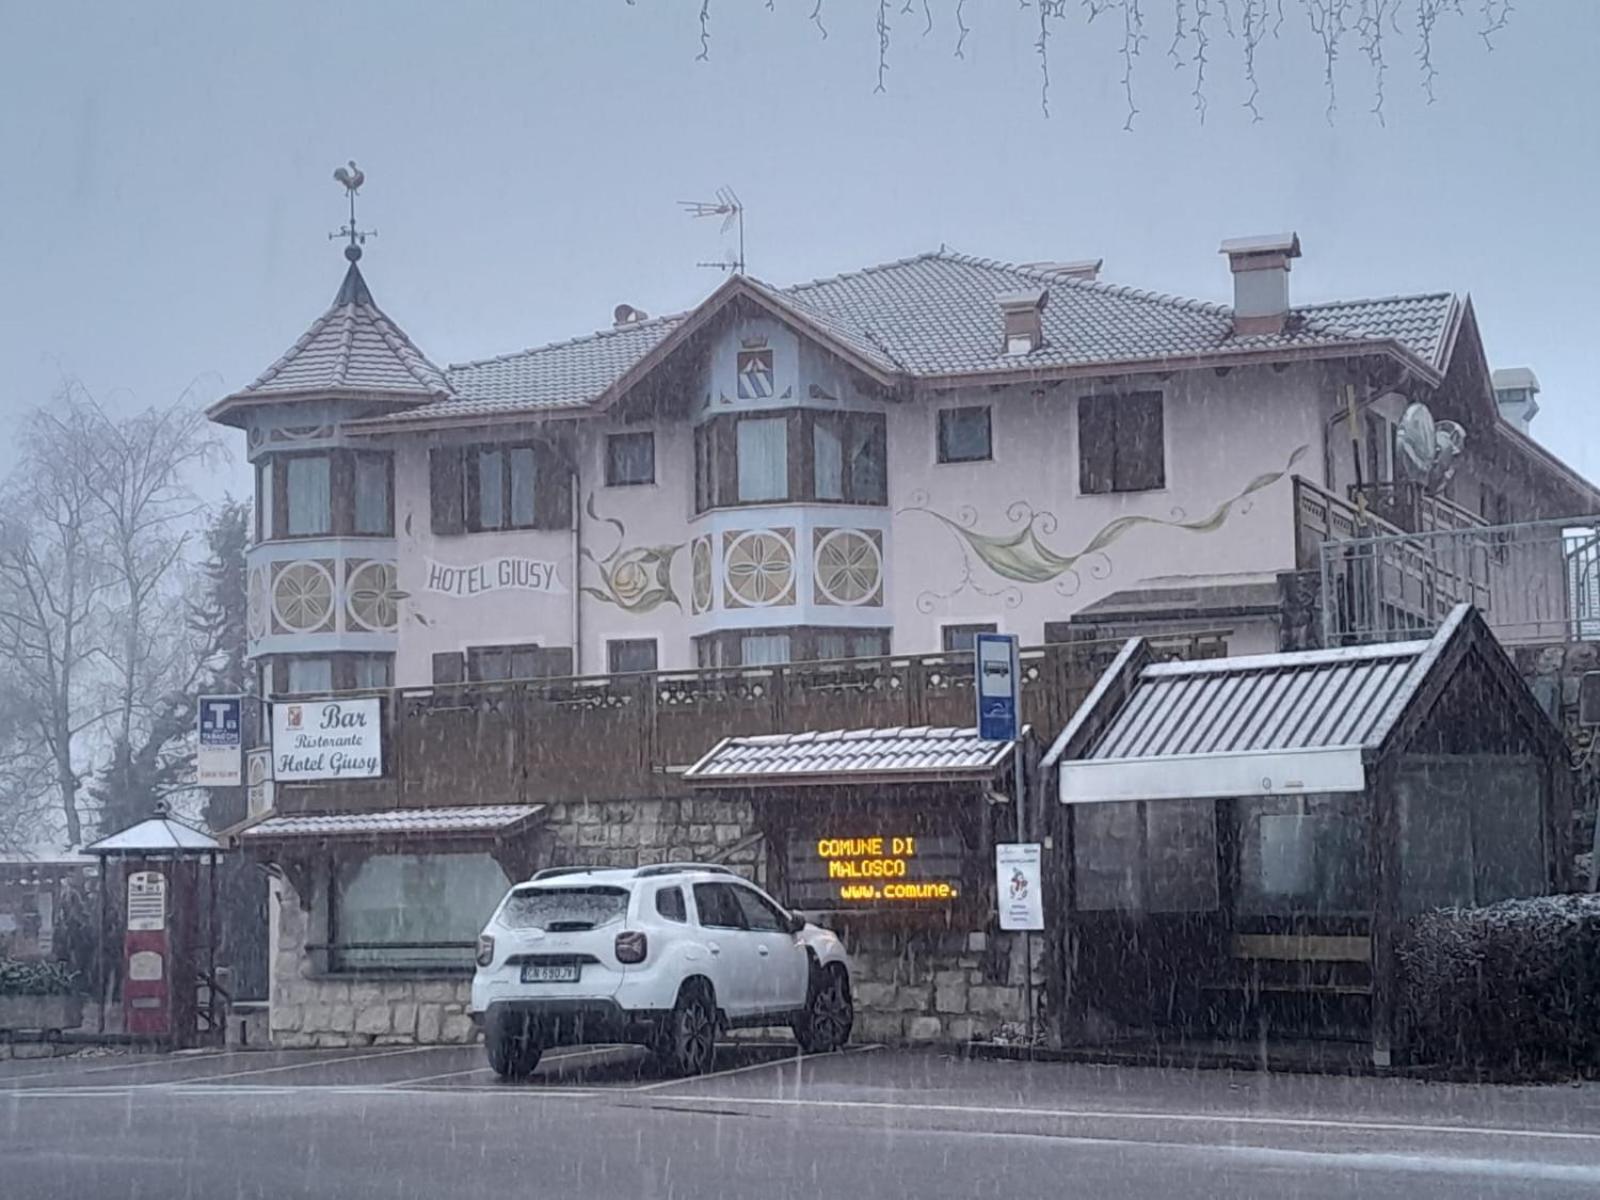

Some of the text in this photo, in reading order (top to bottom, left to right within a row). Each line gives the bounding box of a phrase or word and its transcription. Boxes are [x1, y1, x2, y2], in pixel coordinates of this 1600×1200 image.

[428, 560, 554, 595] HOTEL GIUSY
[320, 704, 367, 729] Bar
[294, 733, 363, 749] Ristorante
[277, 751, 378, 776] Hotel Giusy
[818, 837, 915, 857] COMUNE DI
[829, 860, 906, 877] MALOSCO
[841, 883, 958, 899] www.comune.
